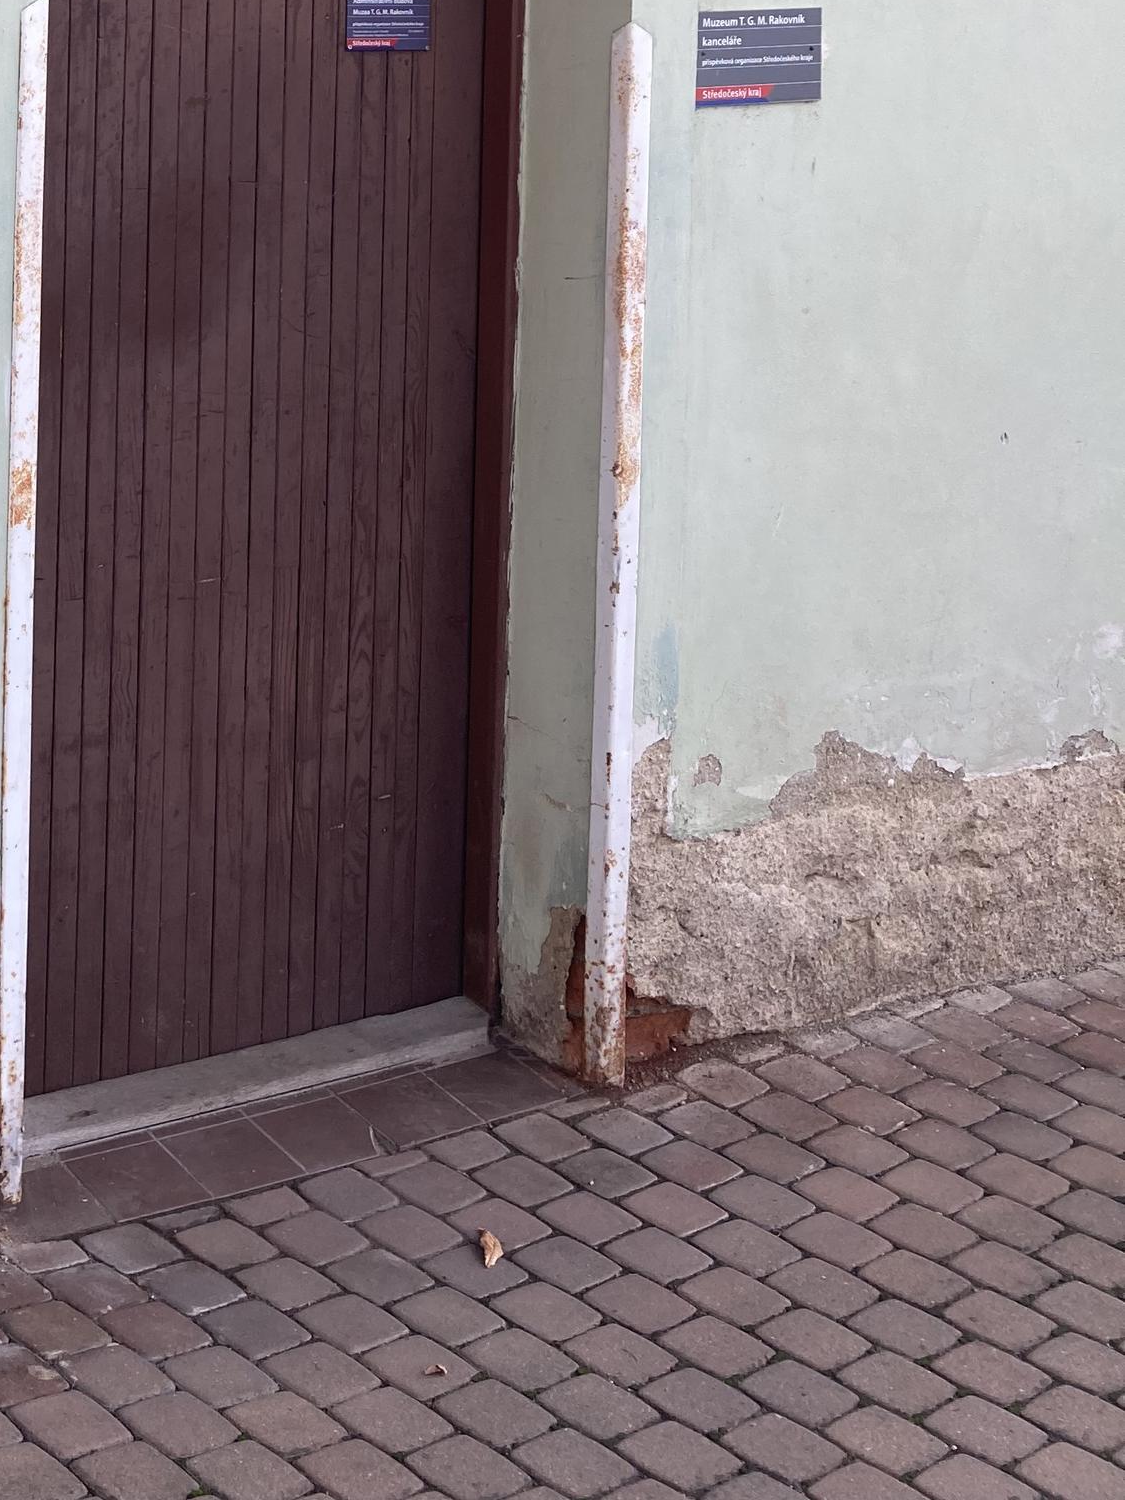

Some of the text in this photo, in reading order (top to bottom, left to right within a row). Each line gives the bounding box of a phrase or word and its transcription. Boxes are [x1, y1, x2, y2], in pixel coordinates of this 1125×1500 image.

[702, 14, 806, 28] Muzeum T. G. M. Rakovník
[702, 36, 742, 46] kanceláře
[702, 87, 762, 99] Středočeský kraj
